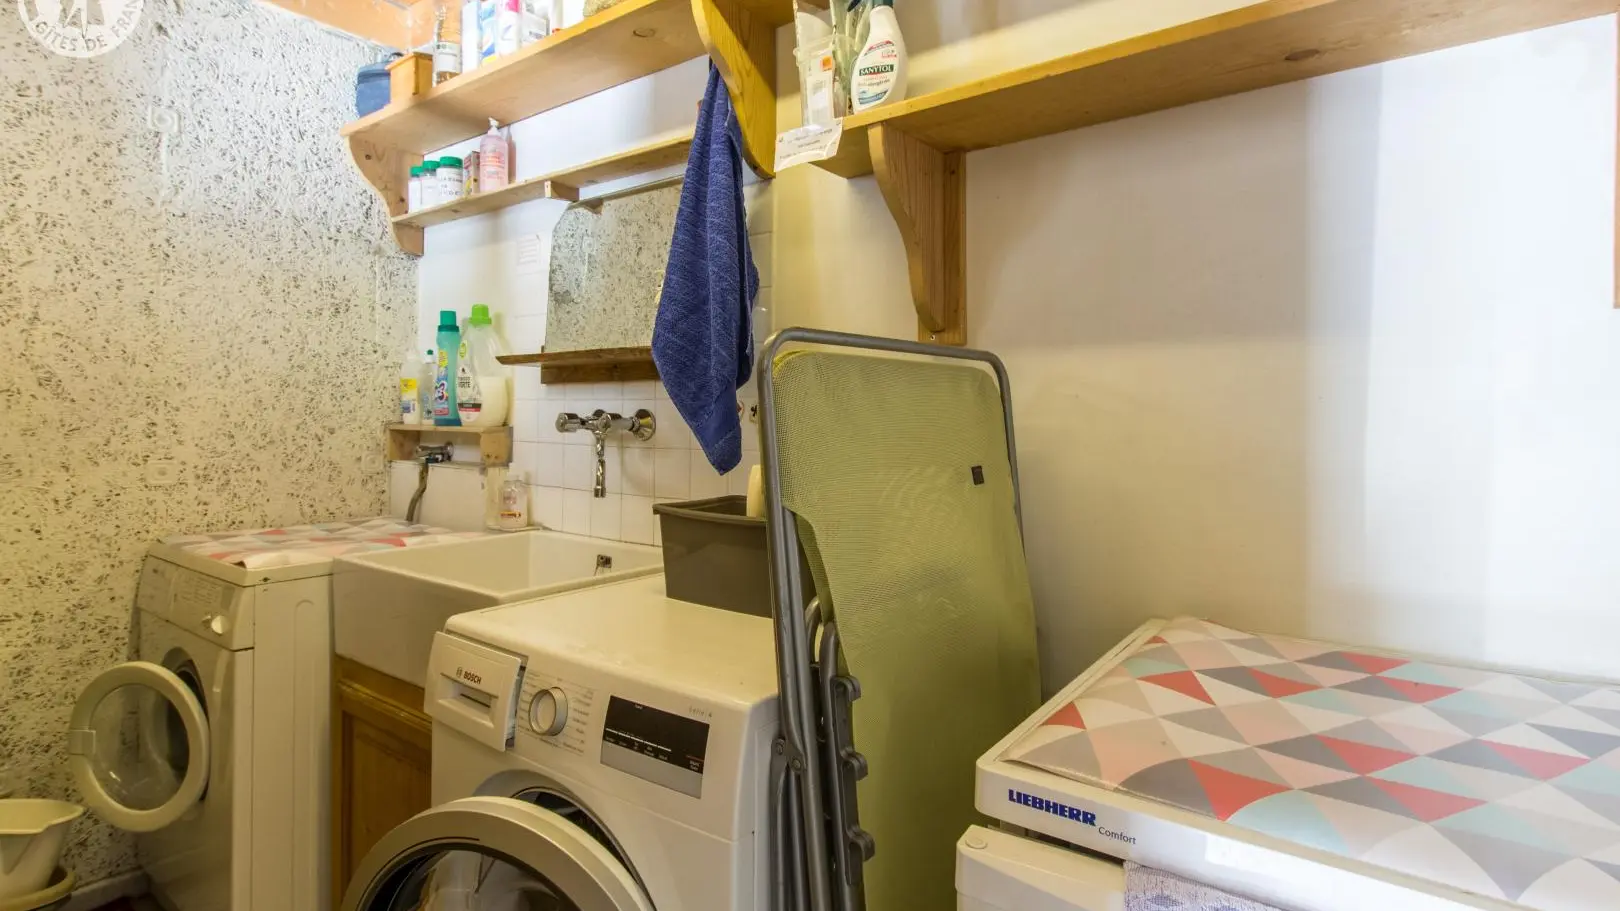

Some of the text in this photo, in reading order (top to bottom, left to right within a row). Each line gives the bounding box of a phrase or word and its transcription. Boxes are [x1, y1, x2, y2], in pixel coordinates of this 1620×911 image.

[860, 64, 893, 75] SANYTOL
[463, 670, 482, 684] BOSCH
[1008, 789, 1096, 826] LIEBHERR
[1098, 826, 1136, 845] Comfort
